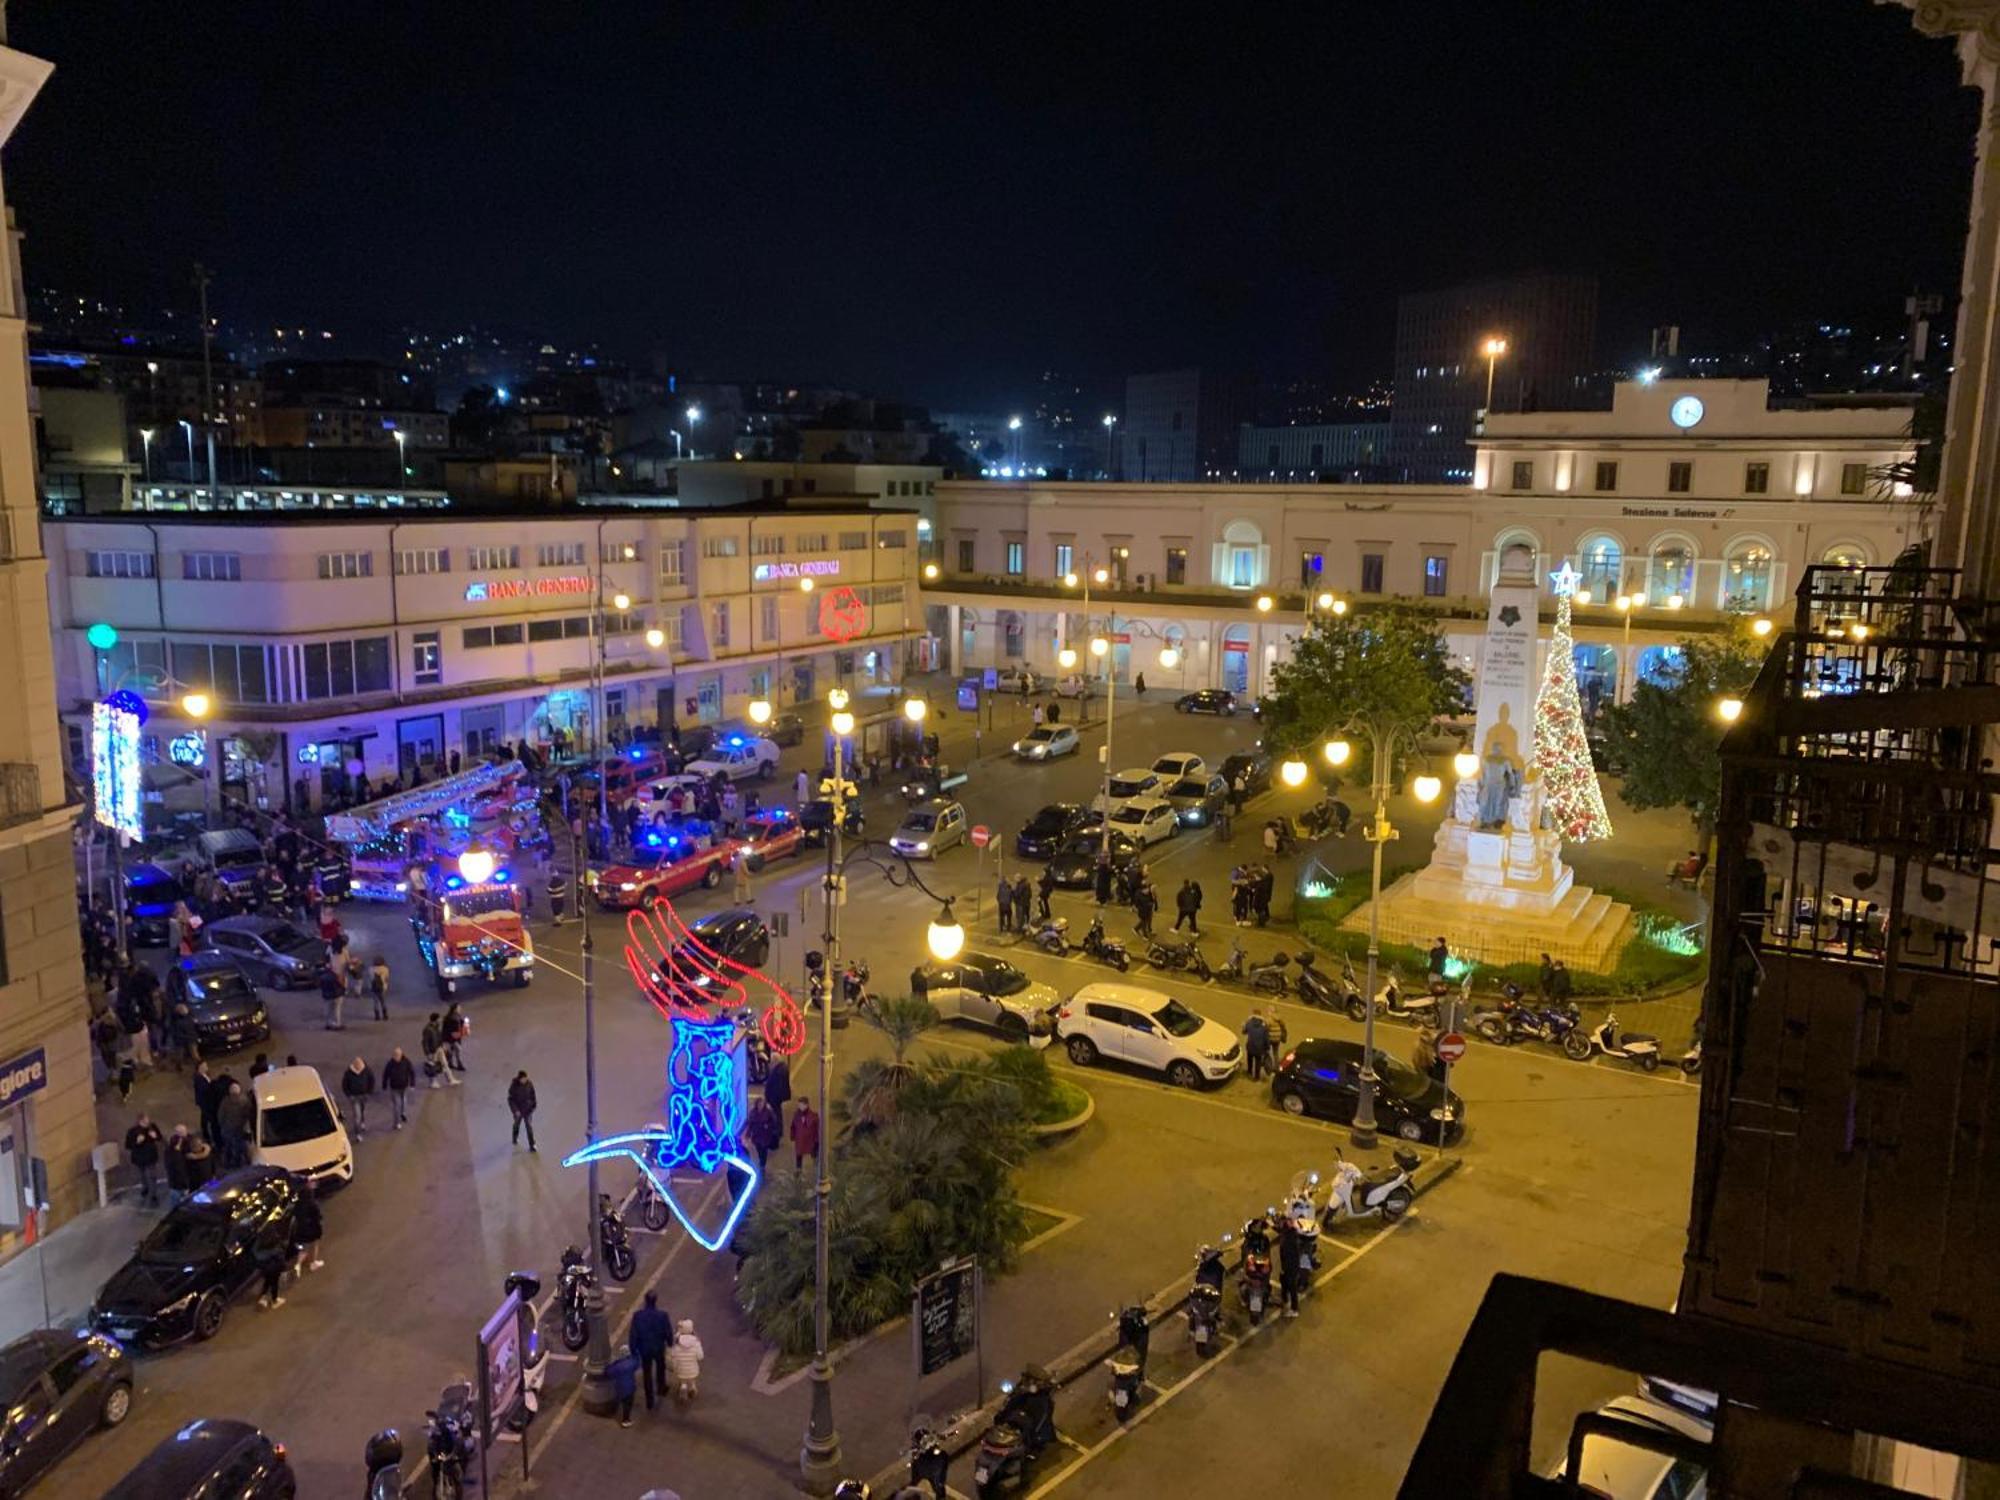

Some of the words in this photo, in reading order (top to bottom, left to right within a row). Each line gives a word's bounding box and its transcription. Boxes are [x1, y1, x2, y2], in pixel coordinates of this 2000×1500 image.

[1622, 506, 1669, 517] Stazione
[769, 563, 799, 579] BANCA
[488, 580, 534, 599] BANCA
